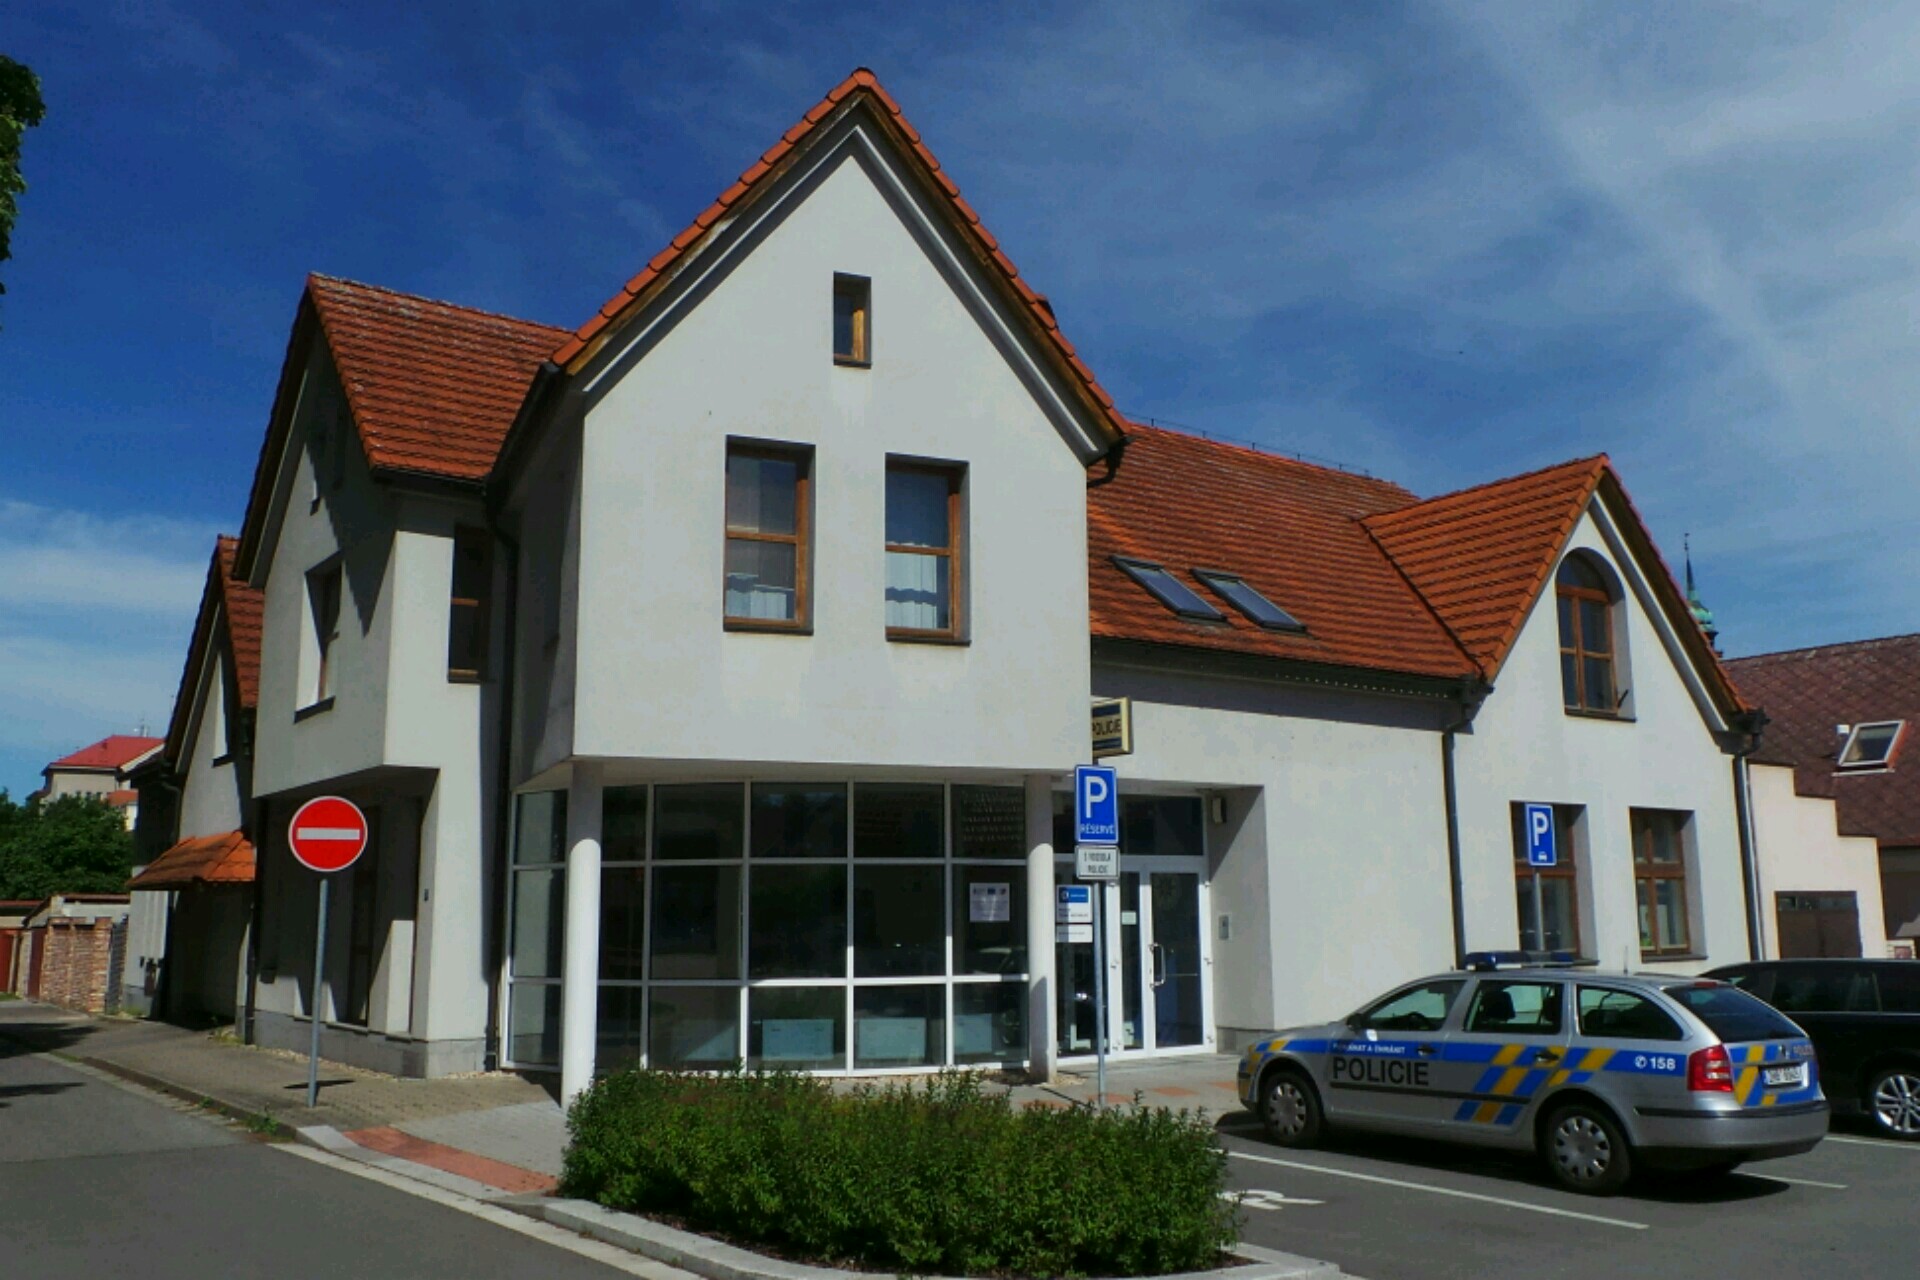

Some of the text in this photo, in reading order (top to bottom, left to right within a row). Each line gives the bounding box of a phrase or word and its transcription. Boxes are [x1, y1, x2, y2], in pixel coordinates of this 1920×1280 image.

[1084, 776, 1108, 819] P
[1532, 811, 1549, 846] P
[1333, 1056, 1429, 1086] POLICIE
[1650, 1056, 1676, 1071] 158
